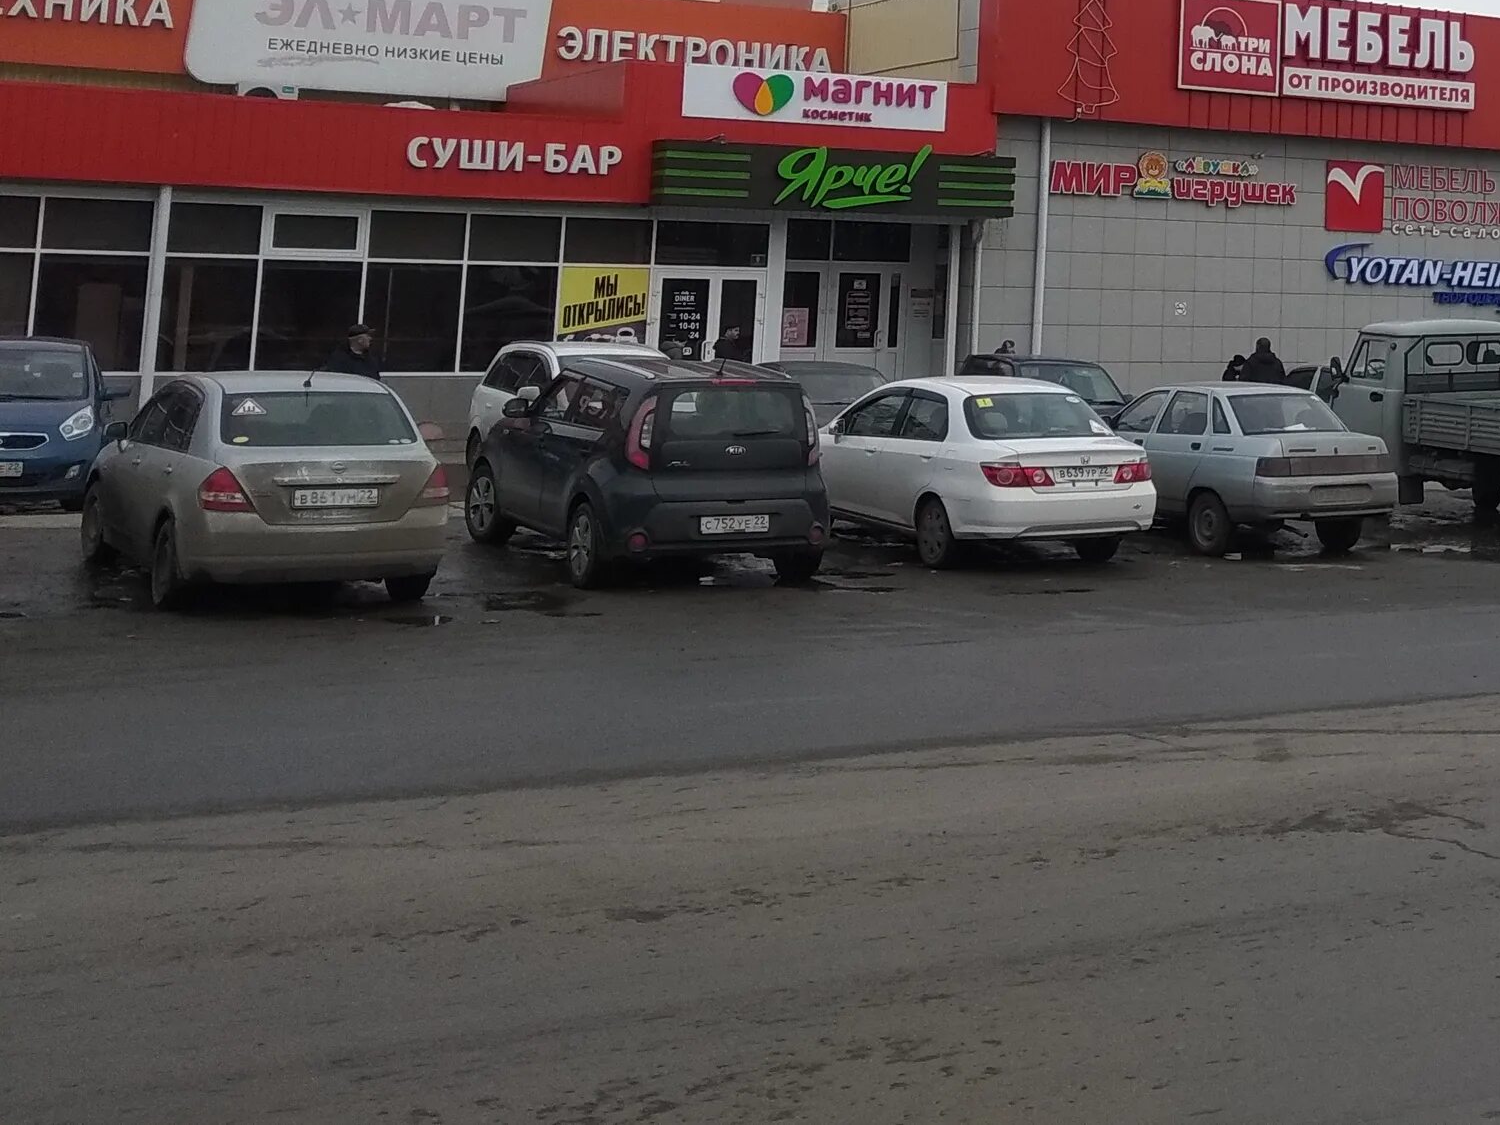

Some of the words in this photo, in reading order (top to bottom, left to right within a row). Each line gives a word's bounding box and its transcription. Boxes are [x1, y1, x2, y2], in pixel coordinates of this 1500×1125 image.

[267, 37, 379, 57] ЕЖЕДНЕВНО
[384, 46, 451, 62] НИЗКИЕ
[455, 49, 504, 66] ЦЕНЫ
[556, 25, 832, 73] ЭЛЕКТРОНИКА
[1239, 36, 1270, 53] ТРИ
[1283, 2, 1476, 73] МЕБЕЛЬ
[1190, 51, 1274, 76] СЛОНА
[1288, 73, 1312, 88] ОТ
[1317, 76, 1470, 103] ПРОИЗВОДИТЕЛЯ
[802, 108, 872, 123] косметик
[406, 136, 623, 175] СУШИ-БАР
[773, 144, 933, 209] Ярче!
[1050, 160, 1138, 197] МИР
[1392, 164, 1497, 195] МЕБЕЛЬ
[1173, 177, 1298, 207] игрушек
[1391, 223, 1441, 238] сеть
[593, 274, 619, 299] МЫ
[562, 293, 646, 328] ОТКРЫЛИСЬ!
[679, 313, 701, 321] 10-24
[678, 322, 700, 330] 10-01
